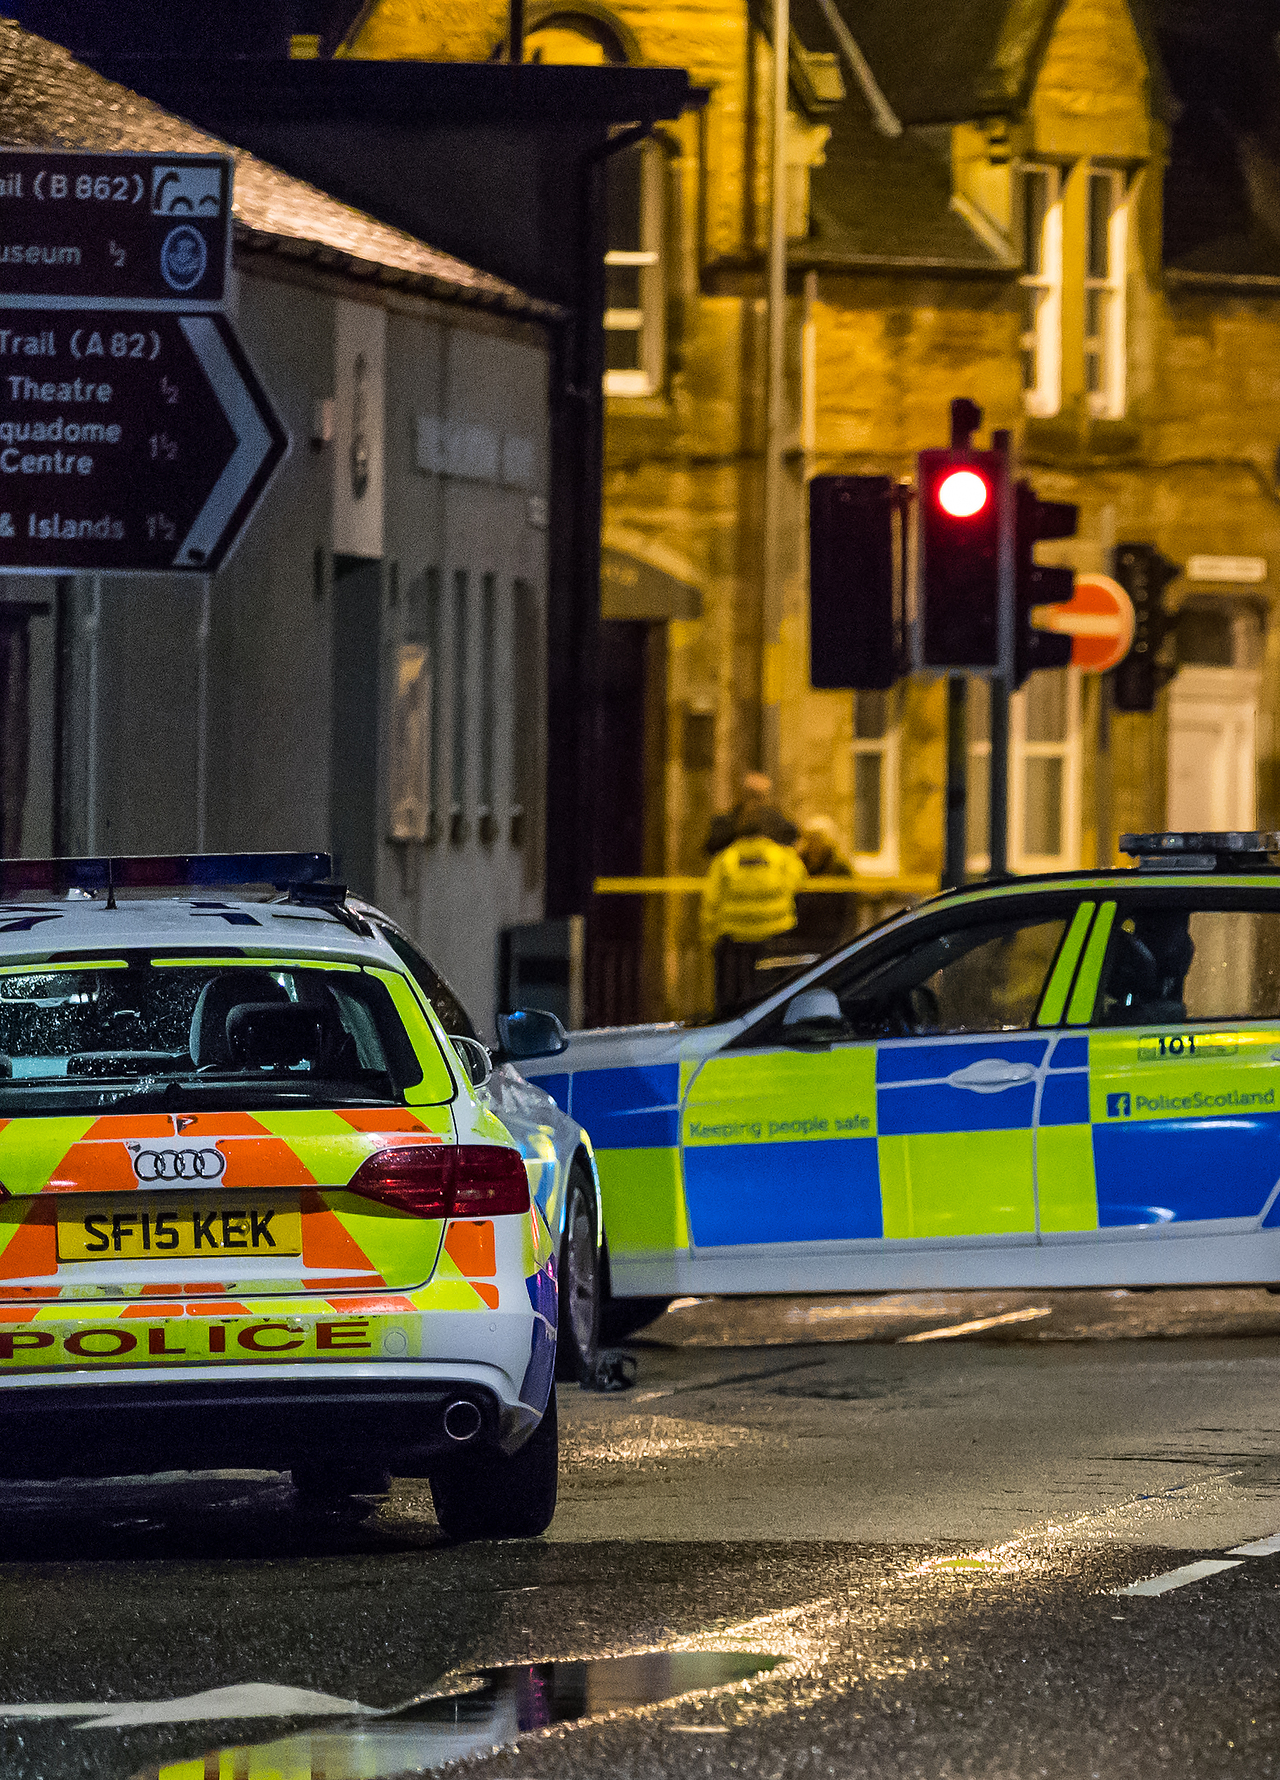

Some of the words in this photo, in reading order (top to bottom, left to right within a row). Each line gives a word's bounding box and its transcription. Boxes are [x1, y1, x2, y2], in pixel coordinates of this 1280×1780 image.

[75, 174, 144, 204] 862)
[0, 329, 56, 356] Trail
[111, 330, 161, 361] 82)
[8, 375, 113, 402] Theatre
[0, 416, 122, 445] quadome
[0, 448, 93, 476] Centre
[0, 512, 15, 538] &
[29, 513, 125, 539] Islands
[1158, 1036, 1196, 1055] 101
[1136, 1088, 1275, 1111] PoliceScotland
[690, 1121, 761, 1138] Keeping
[768, 1117, 828, 1136] people
[834, 1114, 870, 1131] safe
[83, 1211, 180, 1252] SF15
[193, 1209, 277, 1250] KEK
[0, 1321, 372, 1360] POLICE
